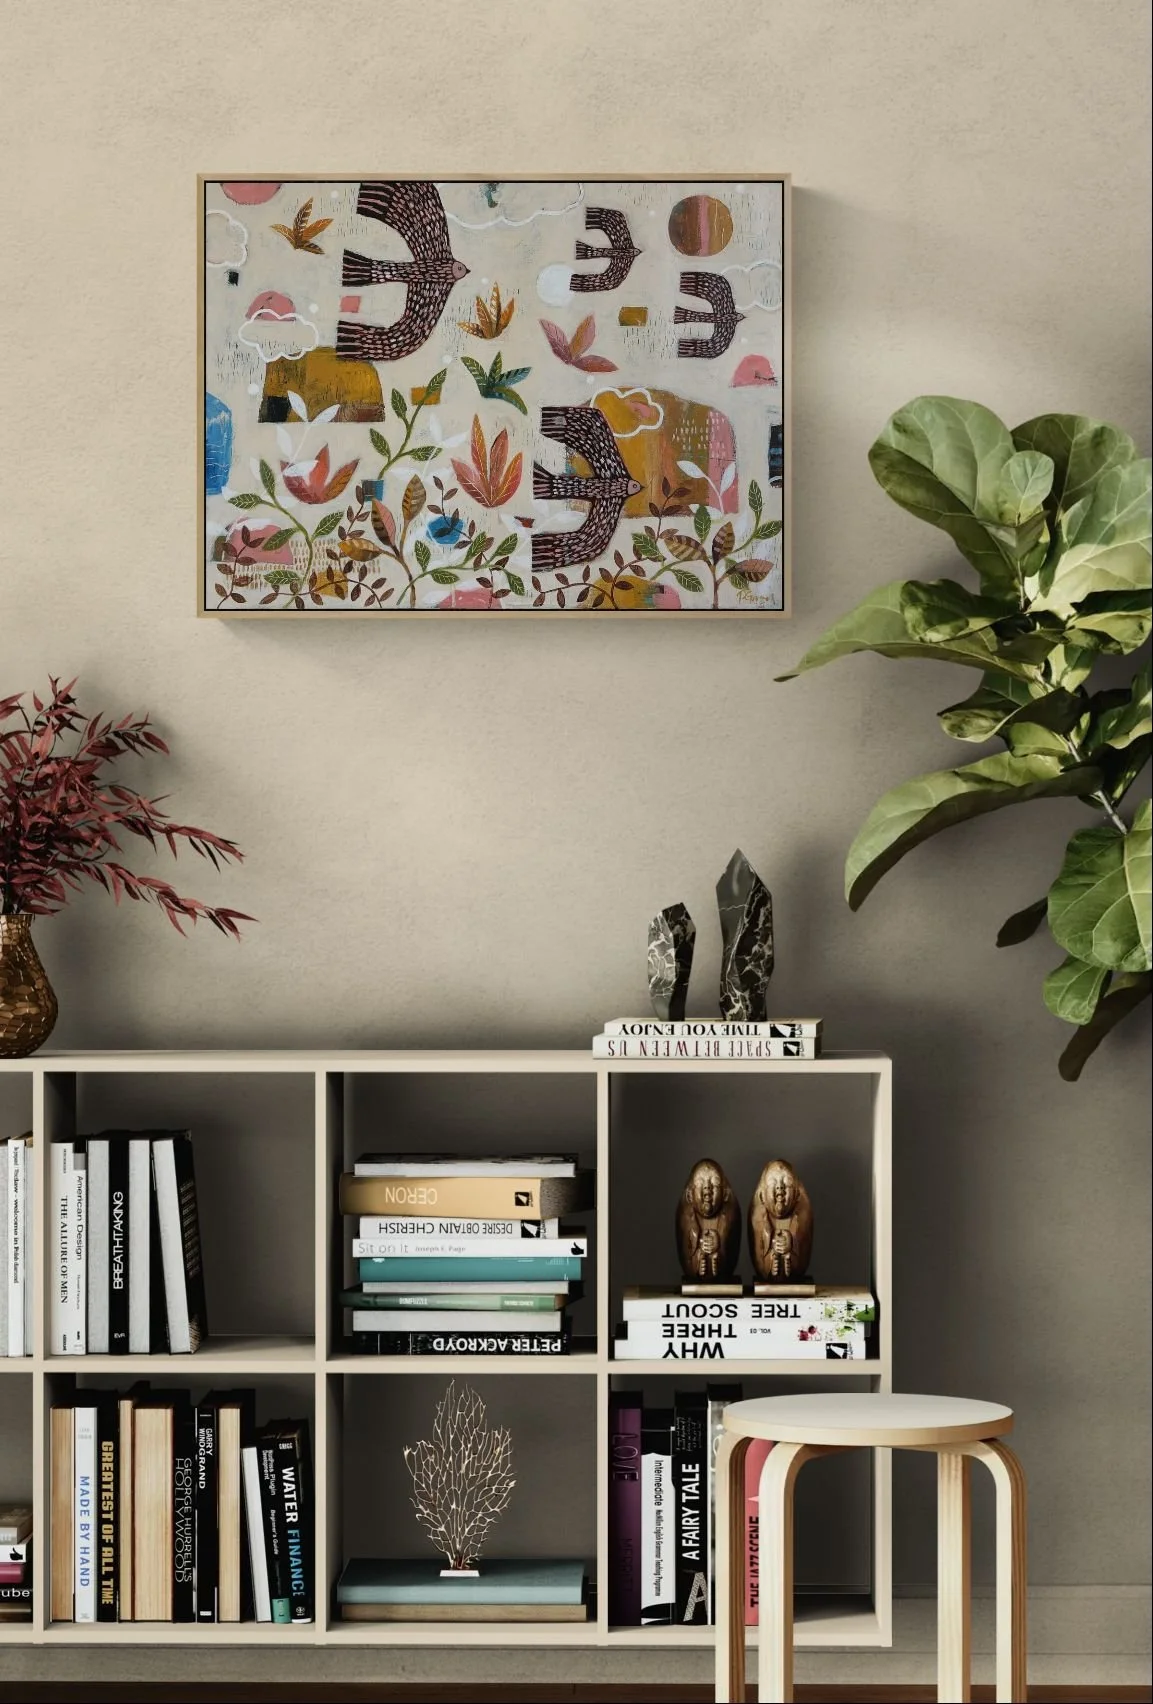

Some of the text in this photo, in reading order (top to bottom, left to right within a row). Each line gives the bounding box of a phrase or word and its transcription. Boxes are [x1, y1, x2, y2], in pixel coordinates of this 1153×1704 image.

[607, 1039, 771, 1057] SPACE BETWEEN US
[619, 1023, 760, 1036] TIME YOU ENJOY
[385, 1187, 438, 1205] CERON
[76, 1175, 84, 1261] American Design
[379, 1223, 512, 1234] DESIRE OBTAIN CHERISH
[60, 1195, 68, 1304] THE ALLURE OF MEN
[113, 1192, 123, 1289] BREATHTAKING
[358, 1242, 376, 1255] Sit
[662, 1303, 801, 1318] TREE SCOUT
[433, 1338, 561, 1352] PETER ACKROYD
[662, 1324, 737, 1338] THREE
[662, 1341, 725, 1359] WHY
[198, 1428, 206, 1489] WINOGRAND
[205, 1428, 213, 1456] GARRY
[281, 1466, 299, 1523] WATER
[653, 1459, 664, 1507] Intermediate
[682, 1464, 699, 1502] TALE
[80, 1476, 90, 1586] MADE BY HAND
[101, 1441, 114, 1604] GREATEST OF ALL TIME
[174, 1457, 184, 1583] HOLLYWOOD
[184, 1457, 193, 1582] GEORGE HURRELL'S
[682, 1507, 699, 1544] FAIRY
[287, 1529, 305, 1597] FINANCE
[682, 1545, 700, 1561] A
[683, 1571, 707, 1622] A
